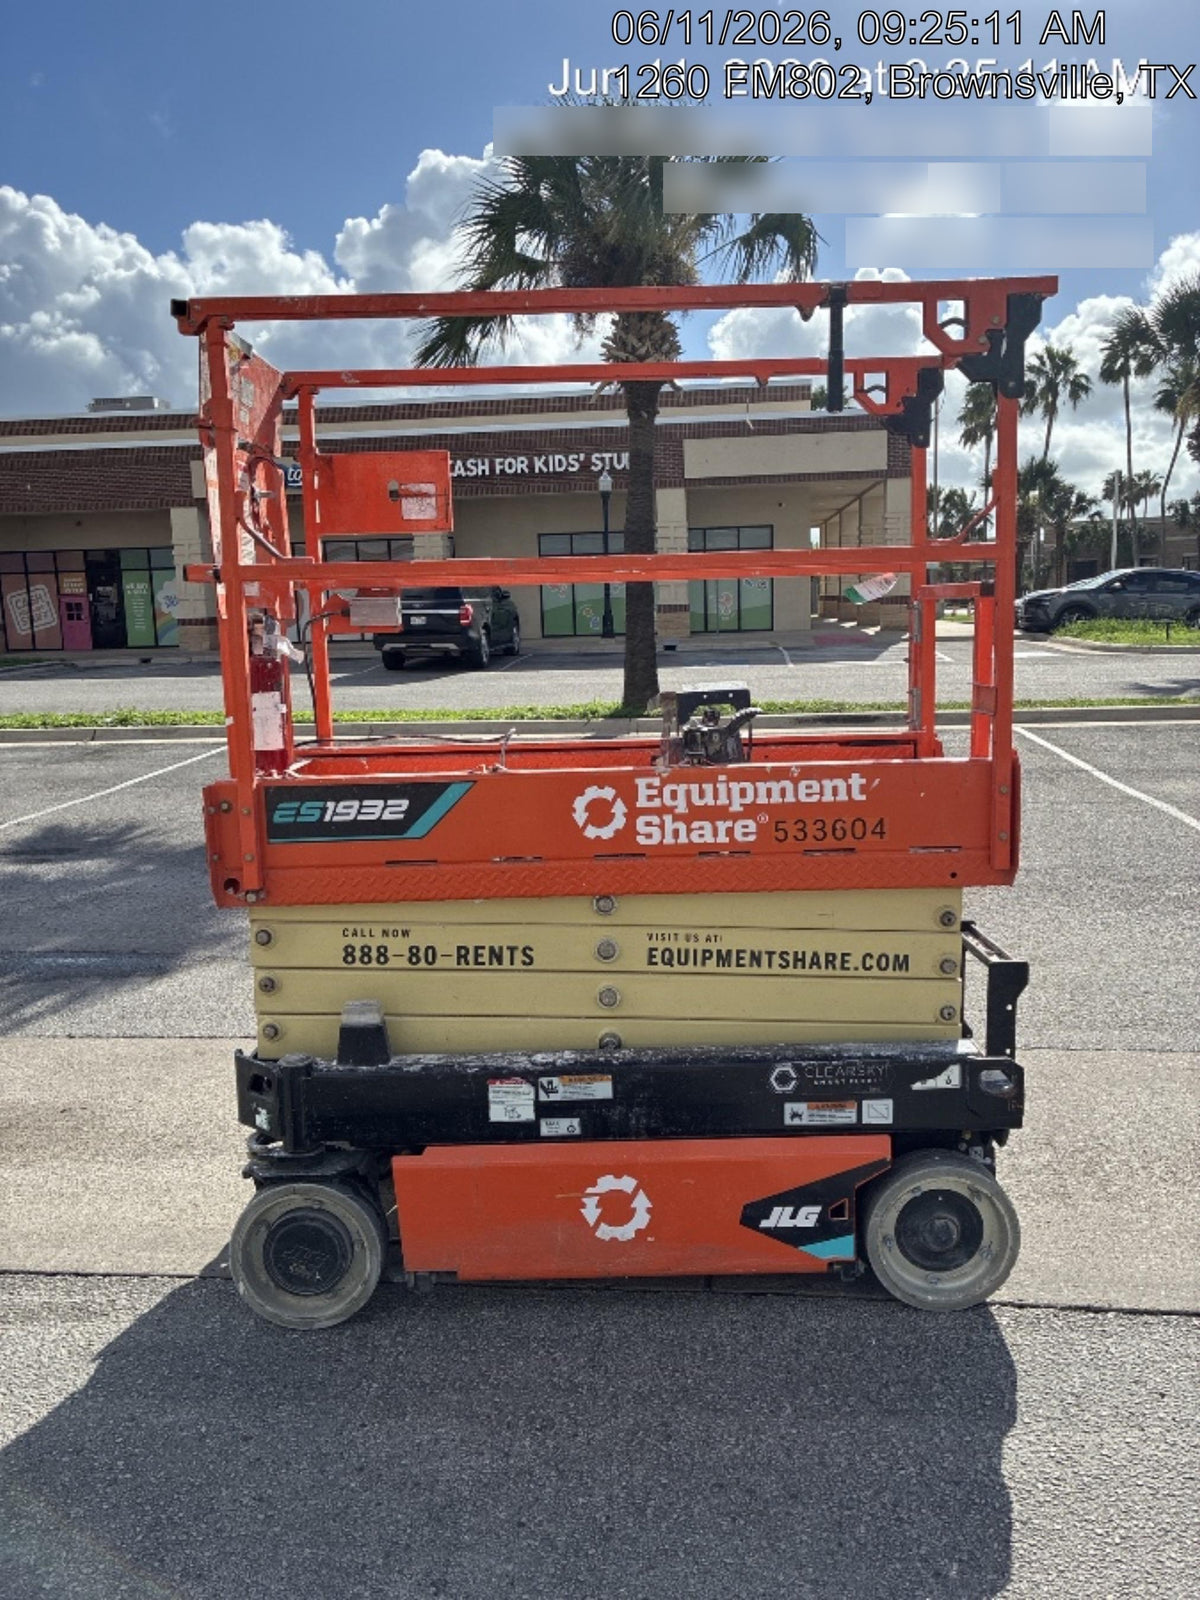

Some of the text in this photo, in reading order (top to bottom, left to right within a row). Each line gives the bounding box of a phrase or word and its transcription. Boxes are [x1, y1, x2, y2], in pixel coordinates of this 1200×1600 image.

[495, 456, 529, 475] FOR
[533, 453, 585, 473] KIDS'
[635, 773, 867, 813] Equipment
[272, 799, 410, 824] ES1932
[774, 817, 887, 843] 533604
[342, 928, 411, 938] CALL NOW
[647, 933, 679, 942] VISIT
[685, 933, 700, 943] US
[342, 944, 535, 966] 888-80-RENTS
[647, 947, 910, 973] EQUIPMENTSHARE.COM
[758, 1206, 822, 1228] JLG
